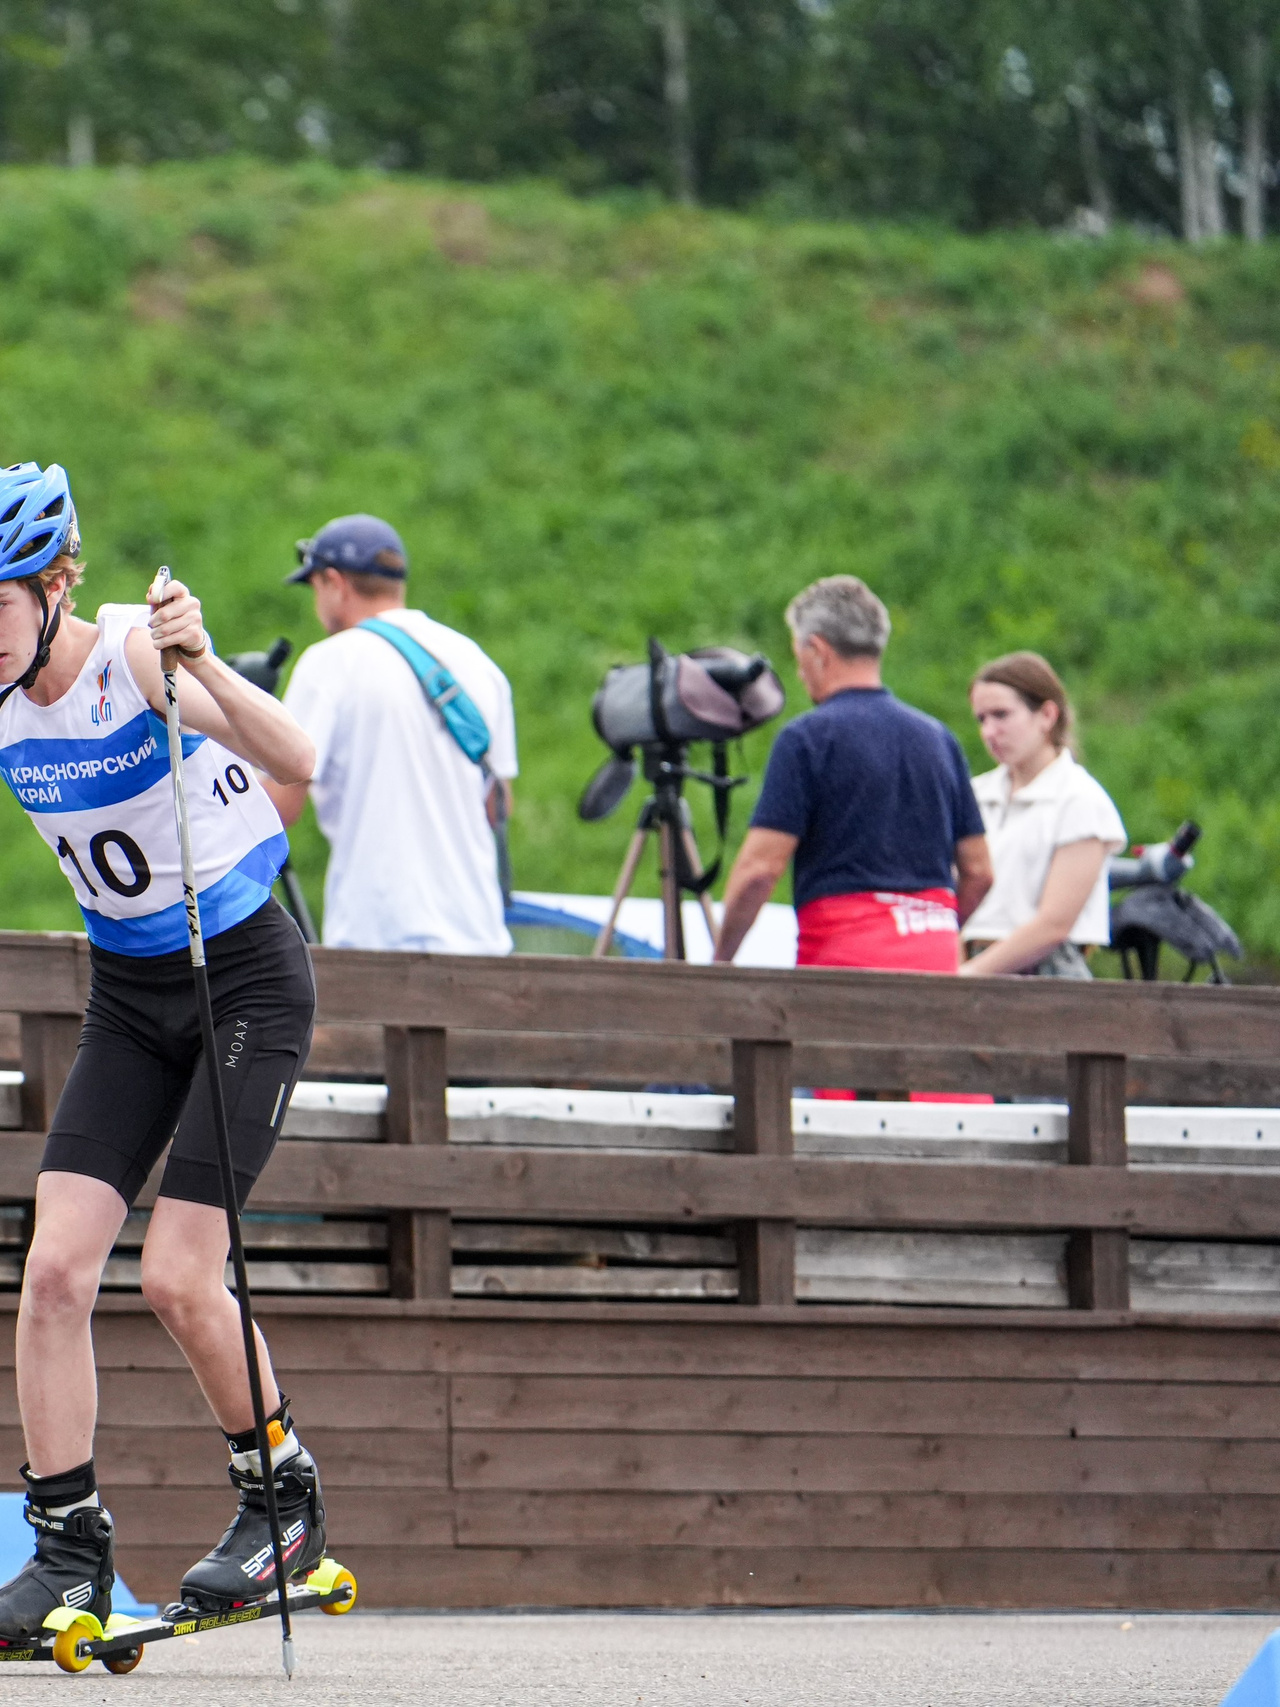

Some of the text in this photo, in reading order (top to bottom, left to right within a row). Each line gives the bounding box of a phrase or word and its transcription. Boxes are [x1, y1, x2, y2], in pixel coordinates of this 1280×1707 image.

[10, 735, 158, 784] КРАСНОЯРСКИЙ
[17, 782, 62, 804] КРАЙ
[212, 763, 250, 807] 10
[57, 829, 151, 898] 10
[225, 1019, 249, 1068] MOAX
[27, 1513, 64, 1531] SPINE
[173, 1606, 262, 1636] START ROLLERSKI
